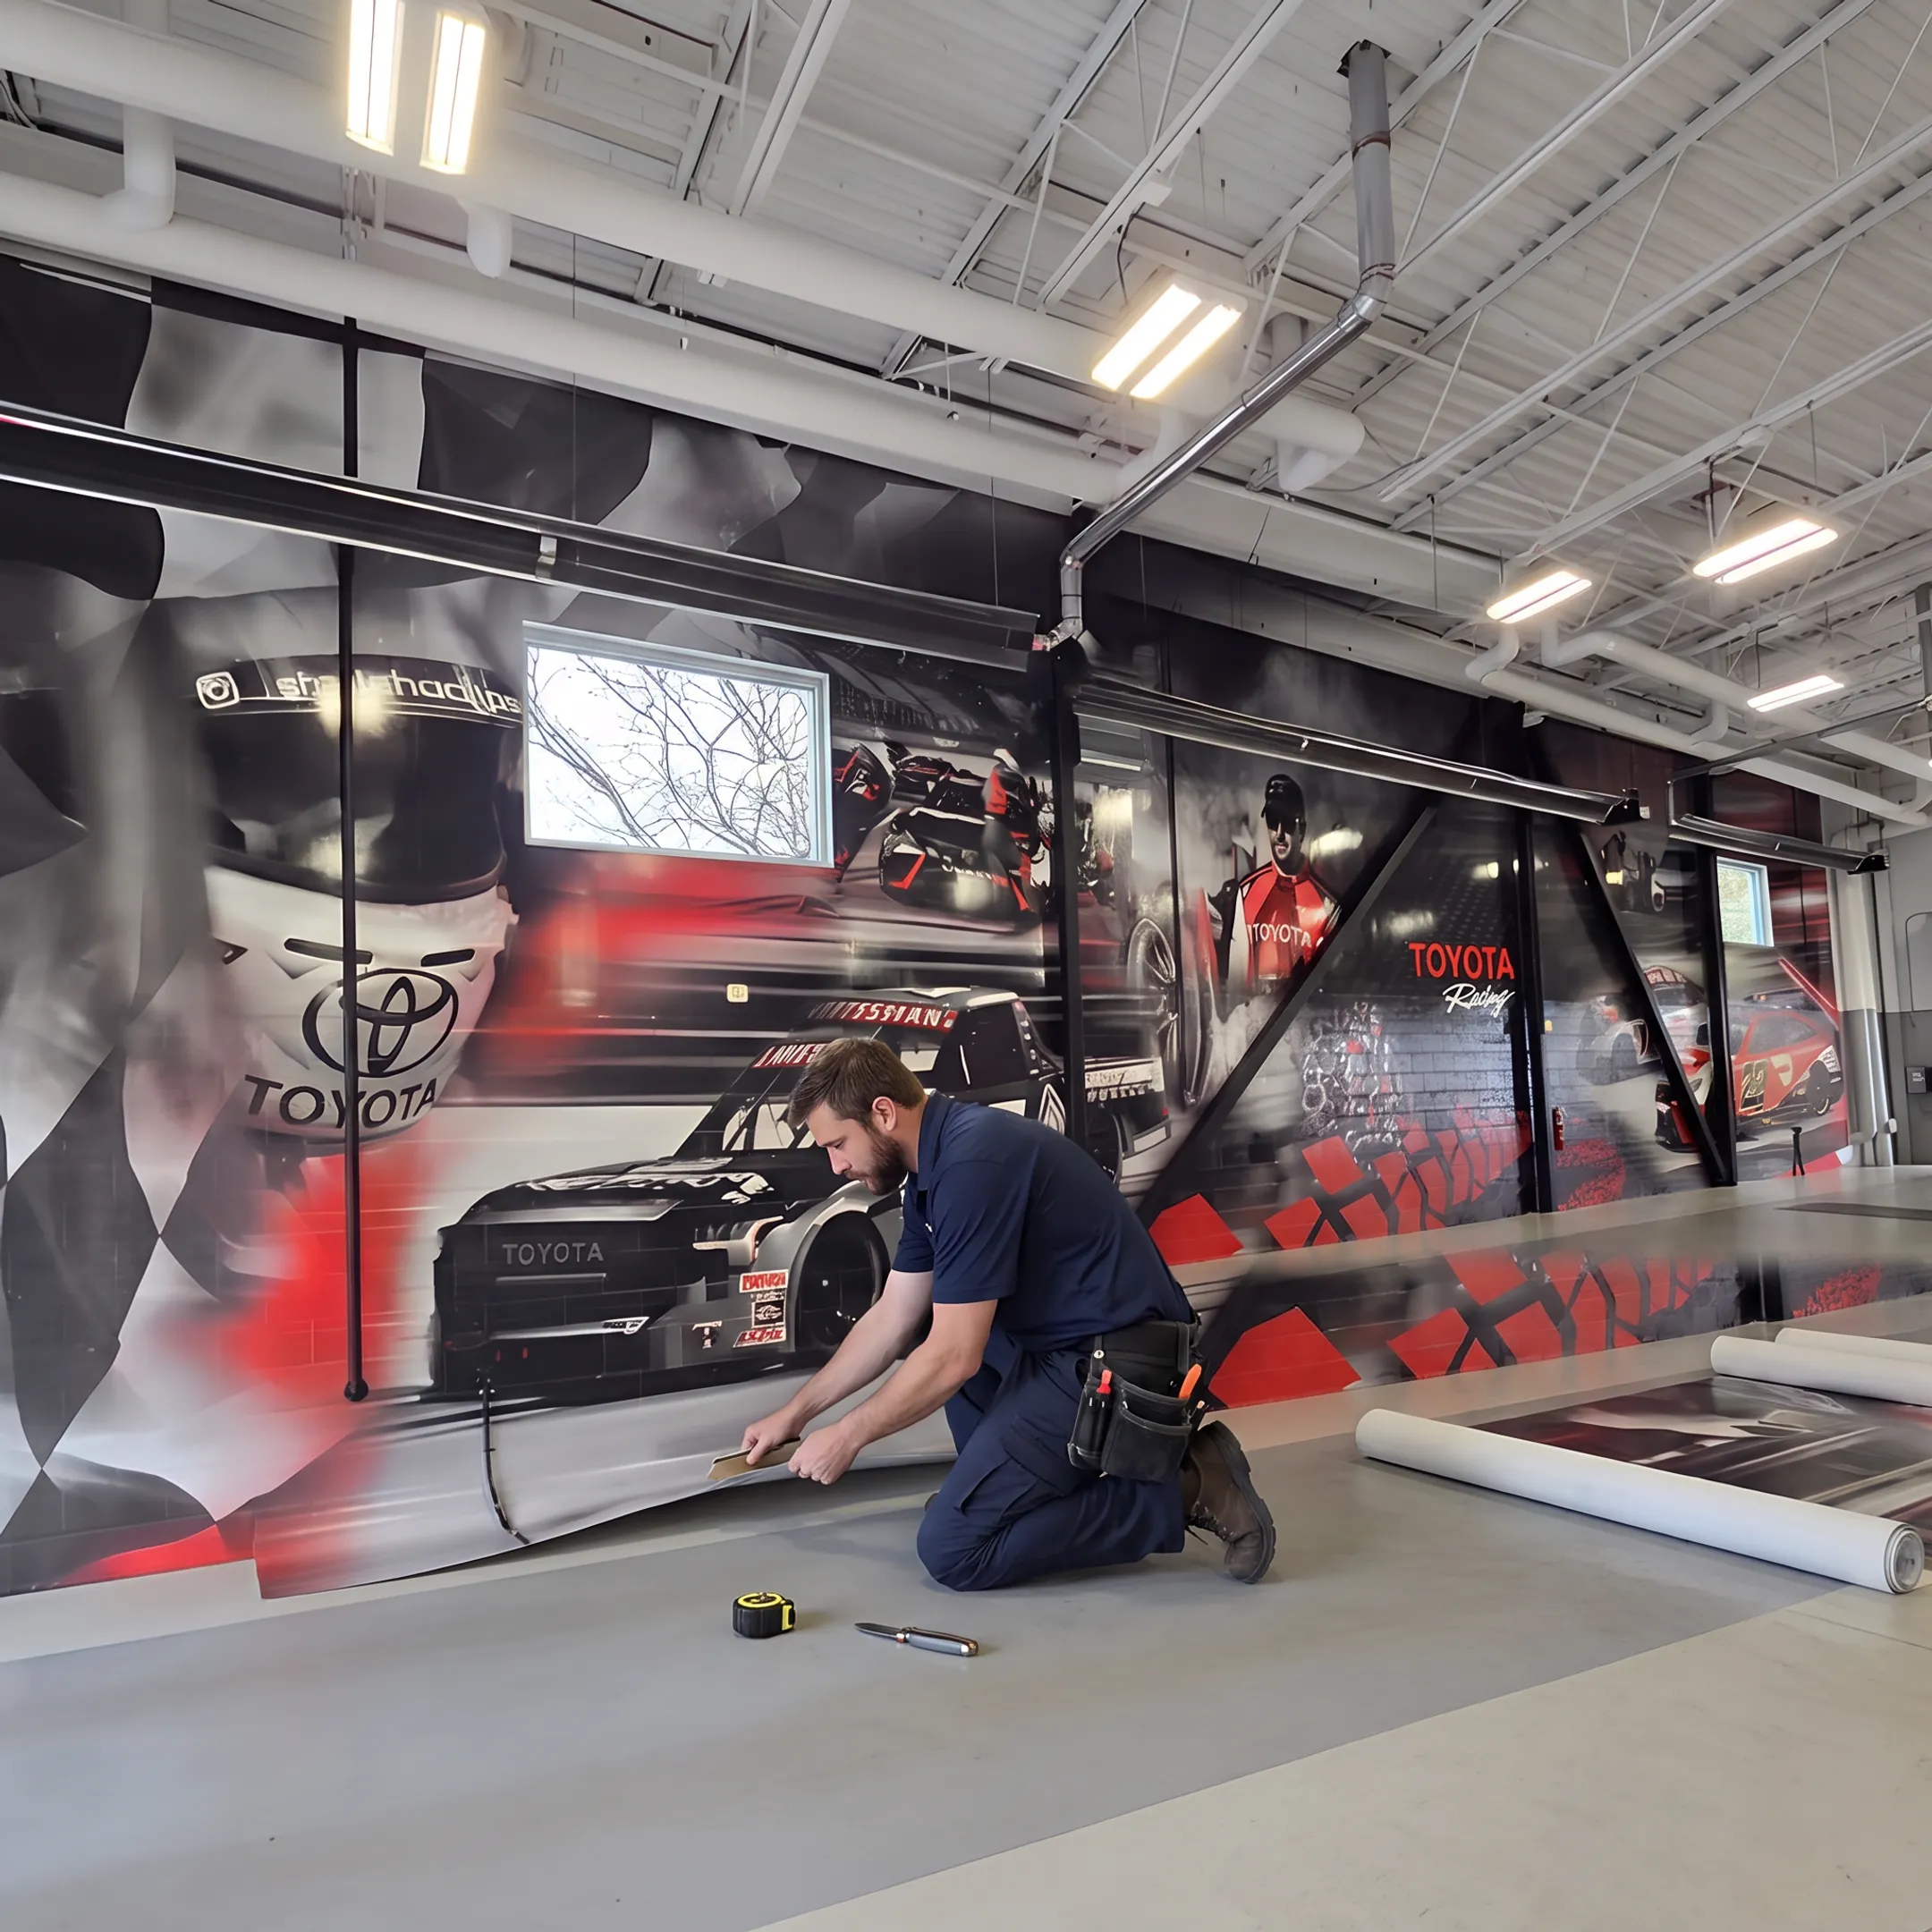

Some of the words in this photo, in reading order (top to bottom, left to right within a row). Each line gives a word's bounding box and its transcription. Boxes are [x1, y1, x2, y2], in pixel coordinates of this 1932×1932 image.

[1252, 923, 1312, 947] TOYOTA
[1409, 943, 1515, 979] TOYOTA
[1442, 983, 1515, 1018] Racing
[245, 1074, 437, 1129] TOYOTA
[502, 1242, 604, 1265] TOYOTA
